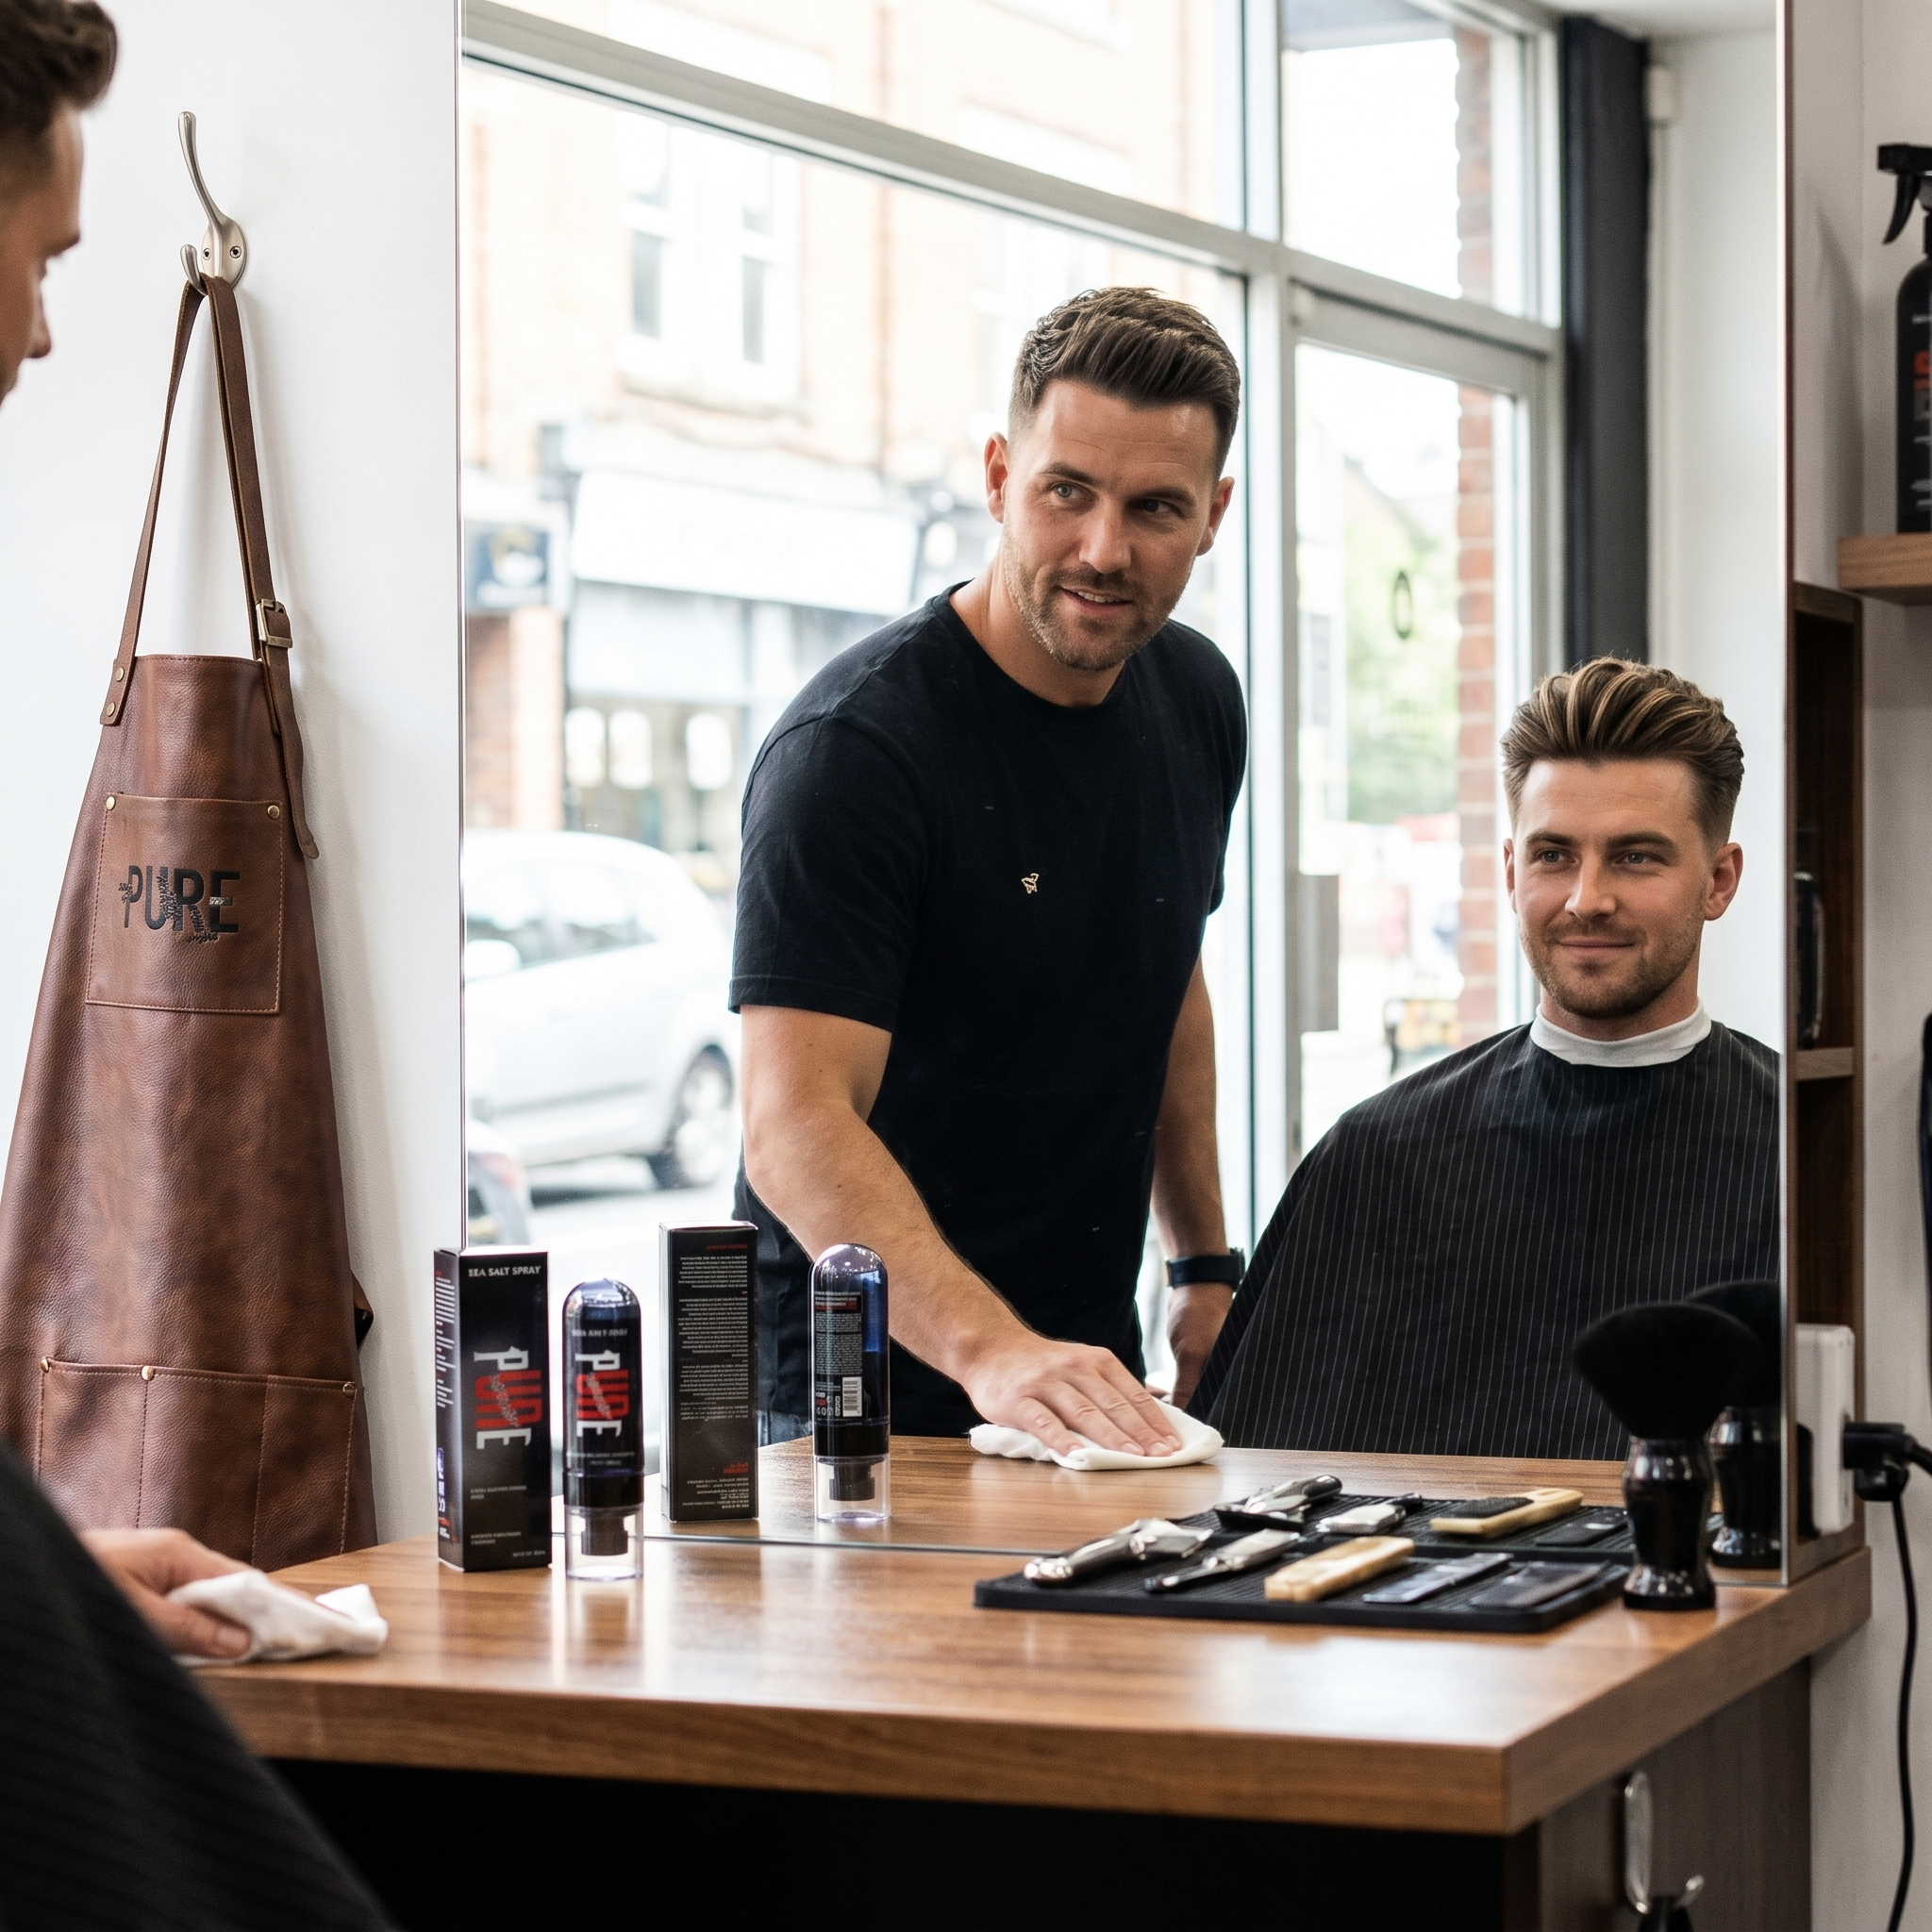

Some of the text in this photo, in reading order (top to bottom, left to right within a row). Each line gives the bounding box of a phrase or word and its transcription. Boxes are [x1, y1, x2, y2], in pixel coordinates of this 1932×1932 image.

[124, 865, 241, 933] PURE
[489, 1267, 509, 1276] SALT
[512, 1265, 541, 1275] SPRAY
[474, 1345, 542, 1450] PURE
